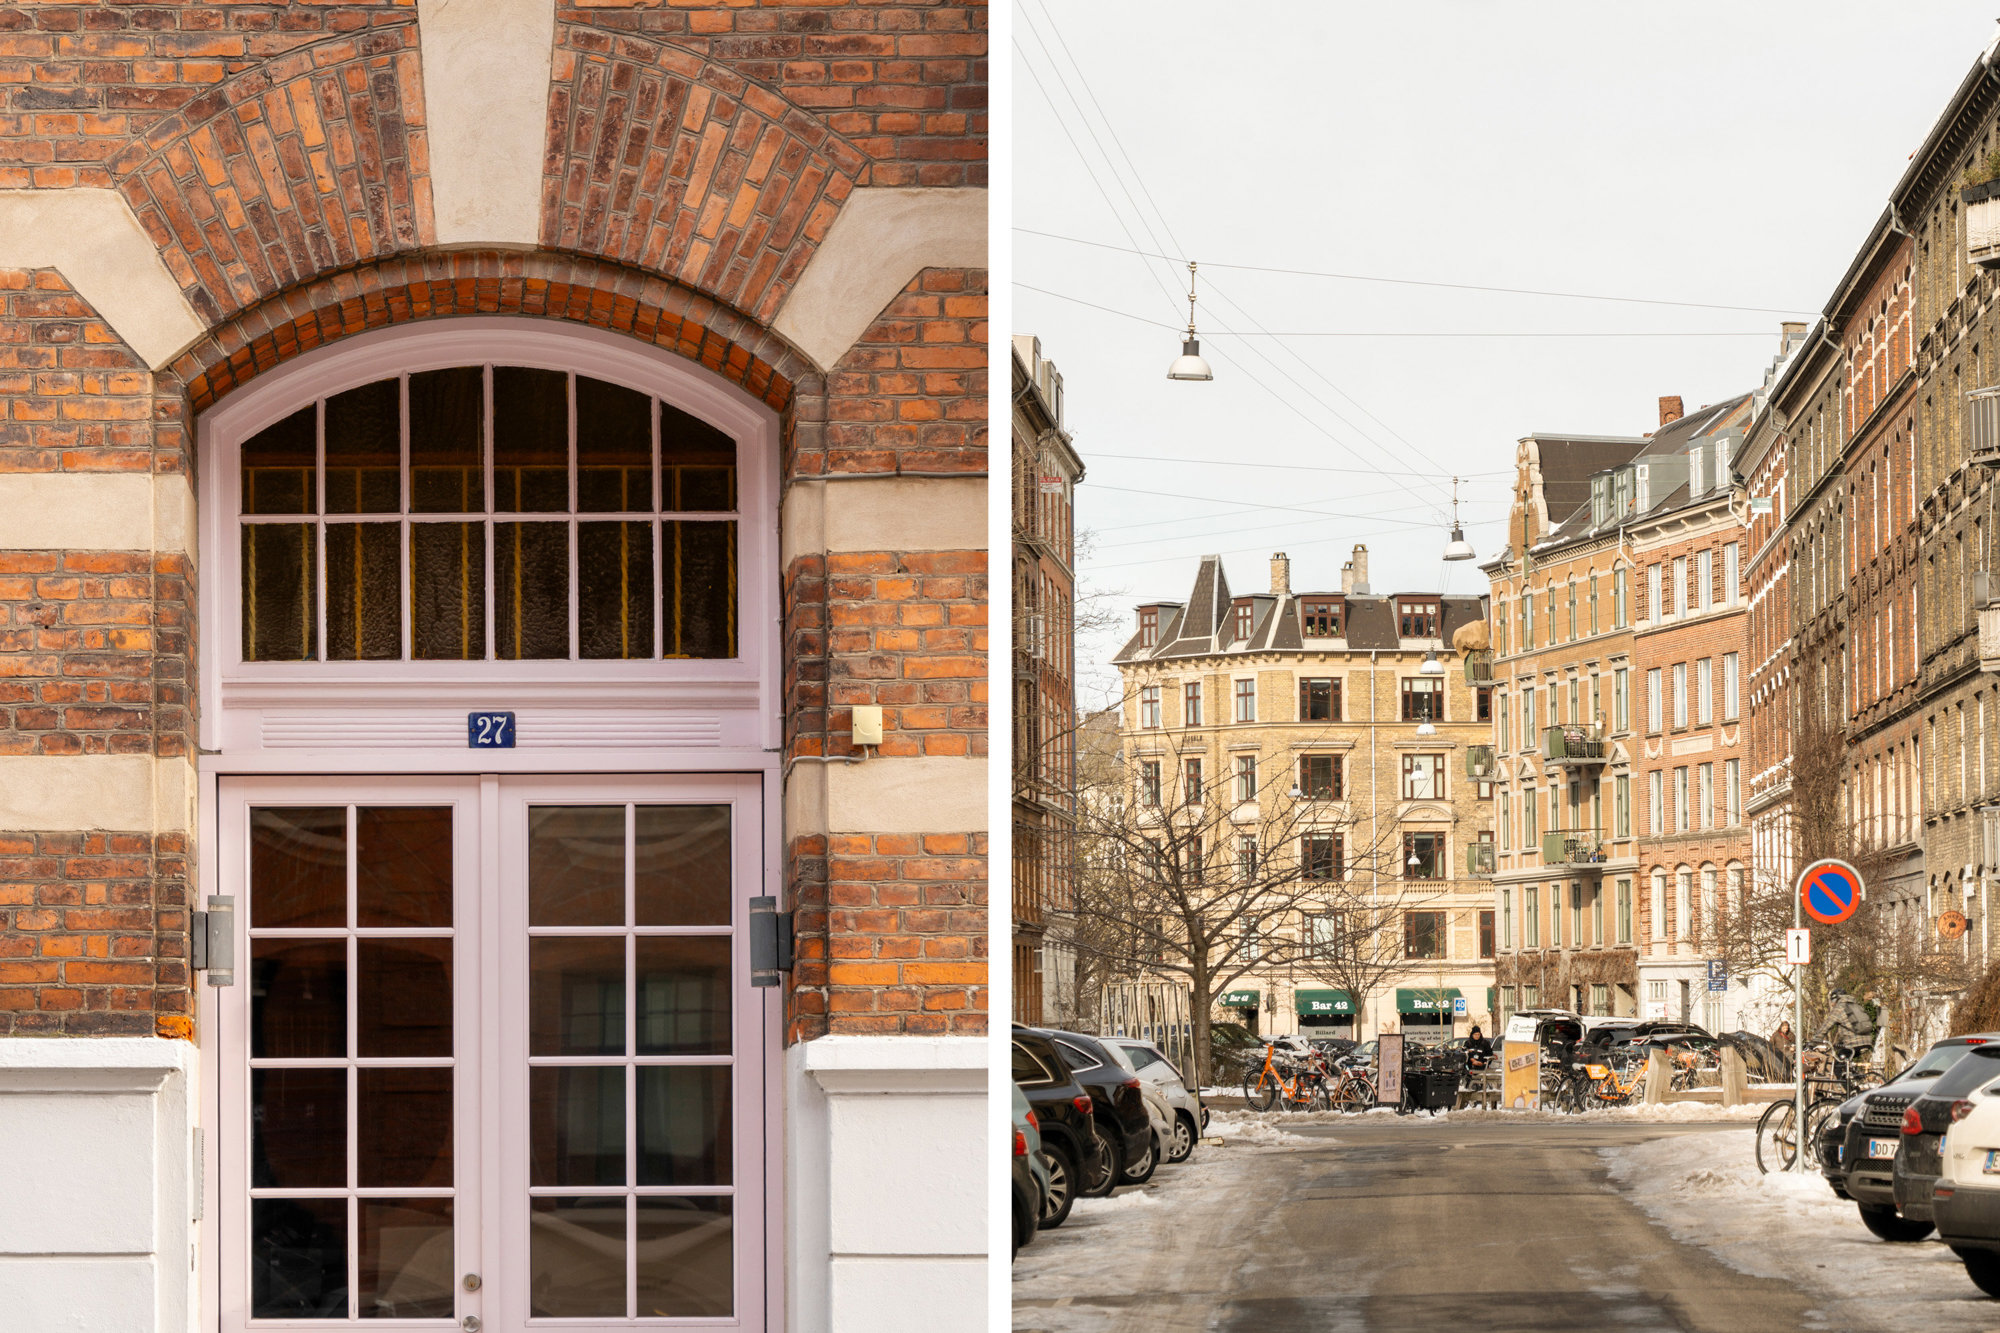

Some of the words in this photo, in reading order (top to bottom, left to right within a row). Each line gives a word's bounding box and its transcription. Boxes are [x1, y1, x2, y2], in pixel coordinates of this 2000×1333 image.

[477, 716, 507, 744] 27
[1312, 1001, 1332, 1010] Bar
[1334, 1001, 1348, 1010] 42
[1413, 1000, 1434, 1008] Bar
[1436, 1000, 1450, 1008] 42
[1875, 1143, 1888, 1155] DD
